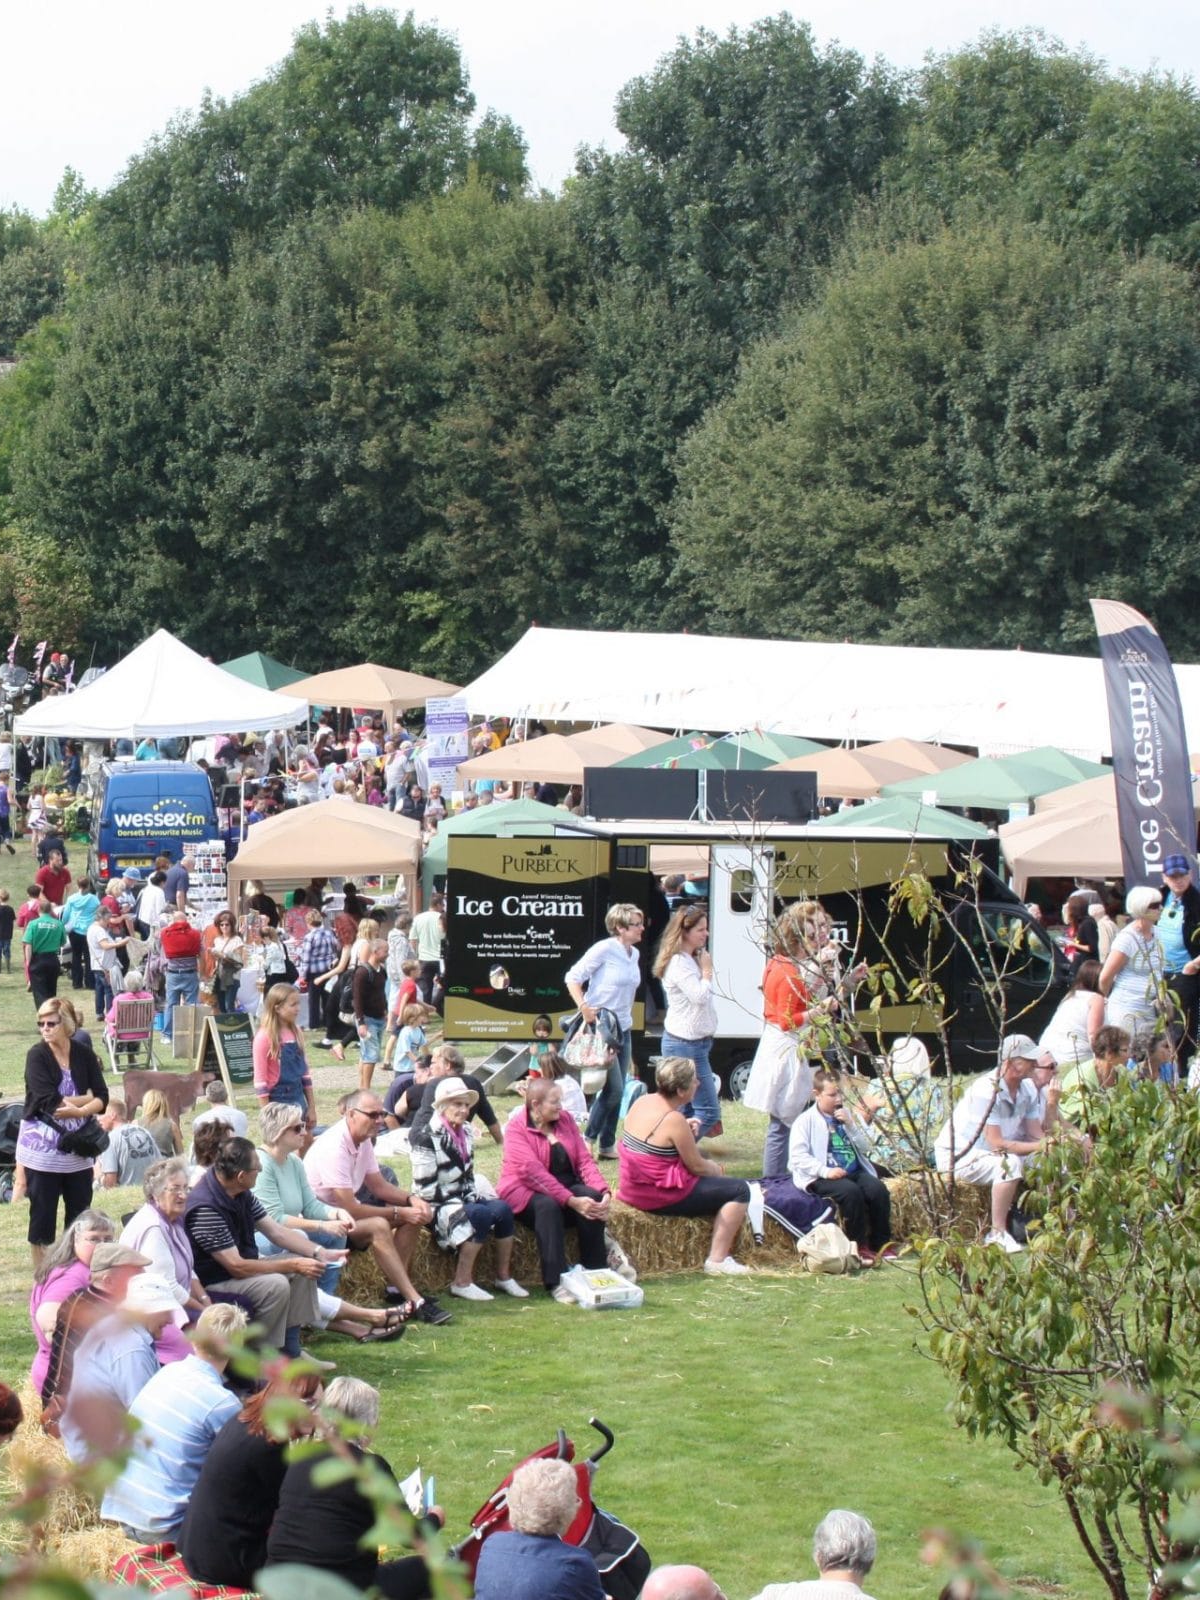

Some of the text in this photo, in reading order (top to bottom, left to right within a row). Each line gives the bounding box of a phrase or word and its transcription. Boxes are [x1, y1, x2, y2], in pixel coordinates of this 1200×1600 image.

[114, 812, 205, 827] wessexfm
[181, 828, 203, 836] Music
[502, 855, 583, 875] PURBECK
[456, 896, 584, 917] Ice Cream
